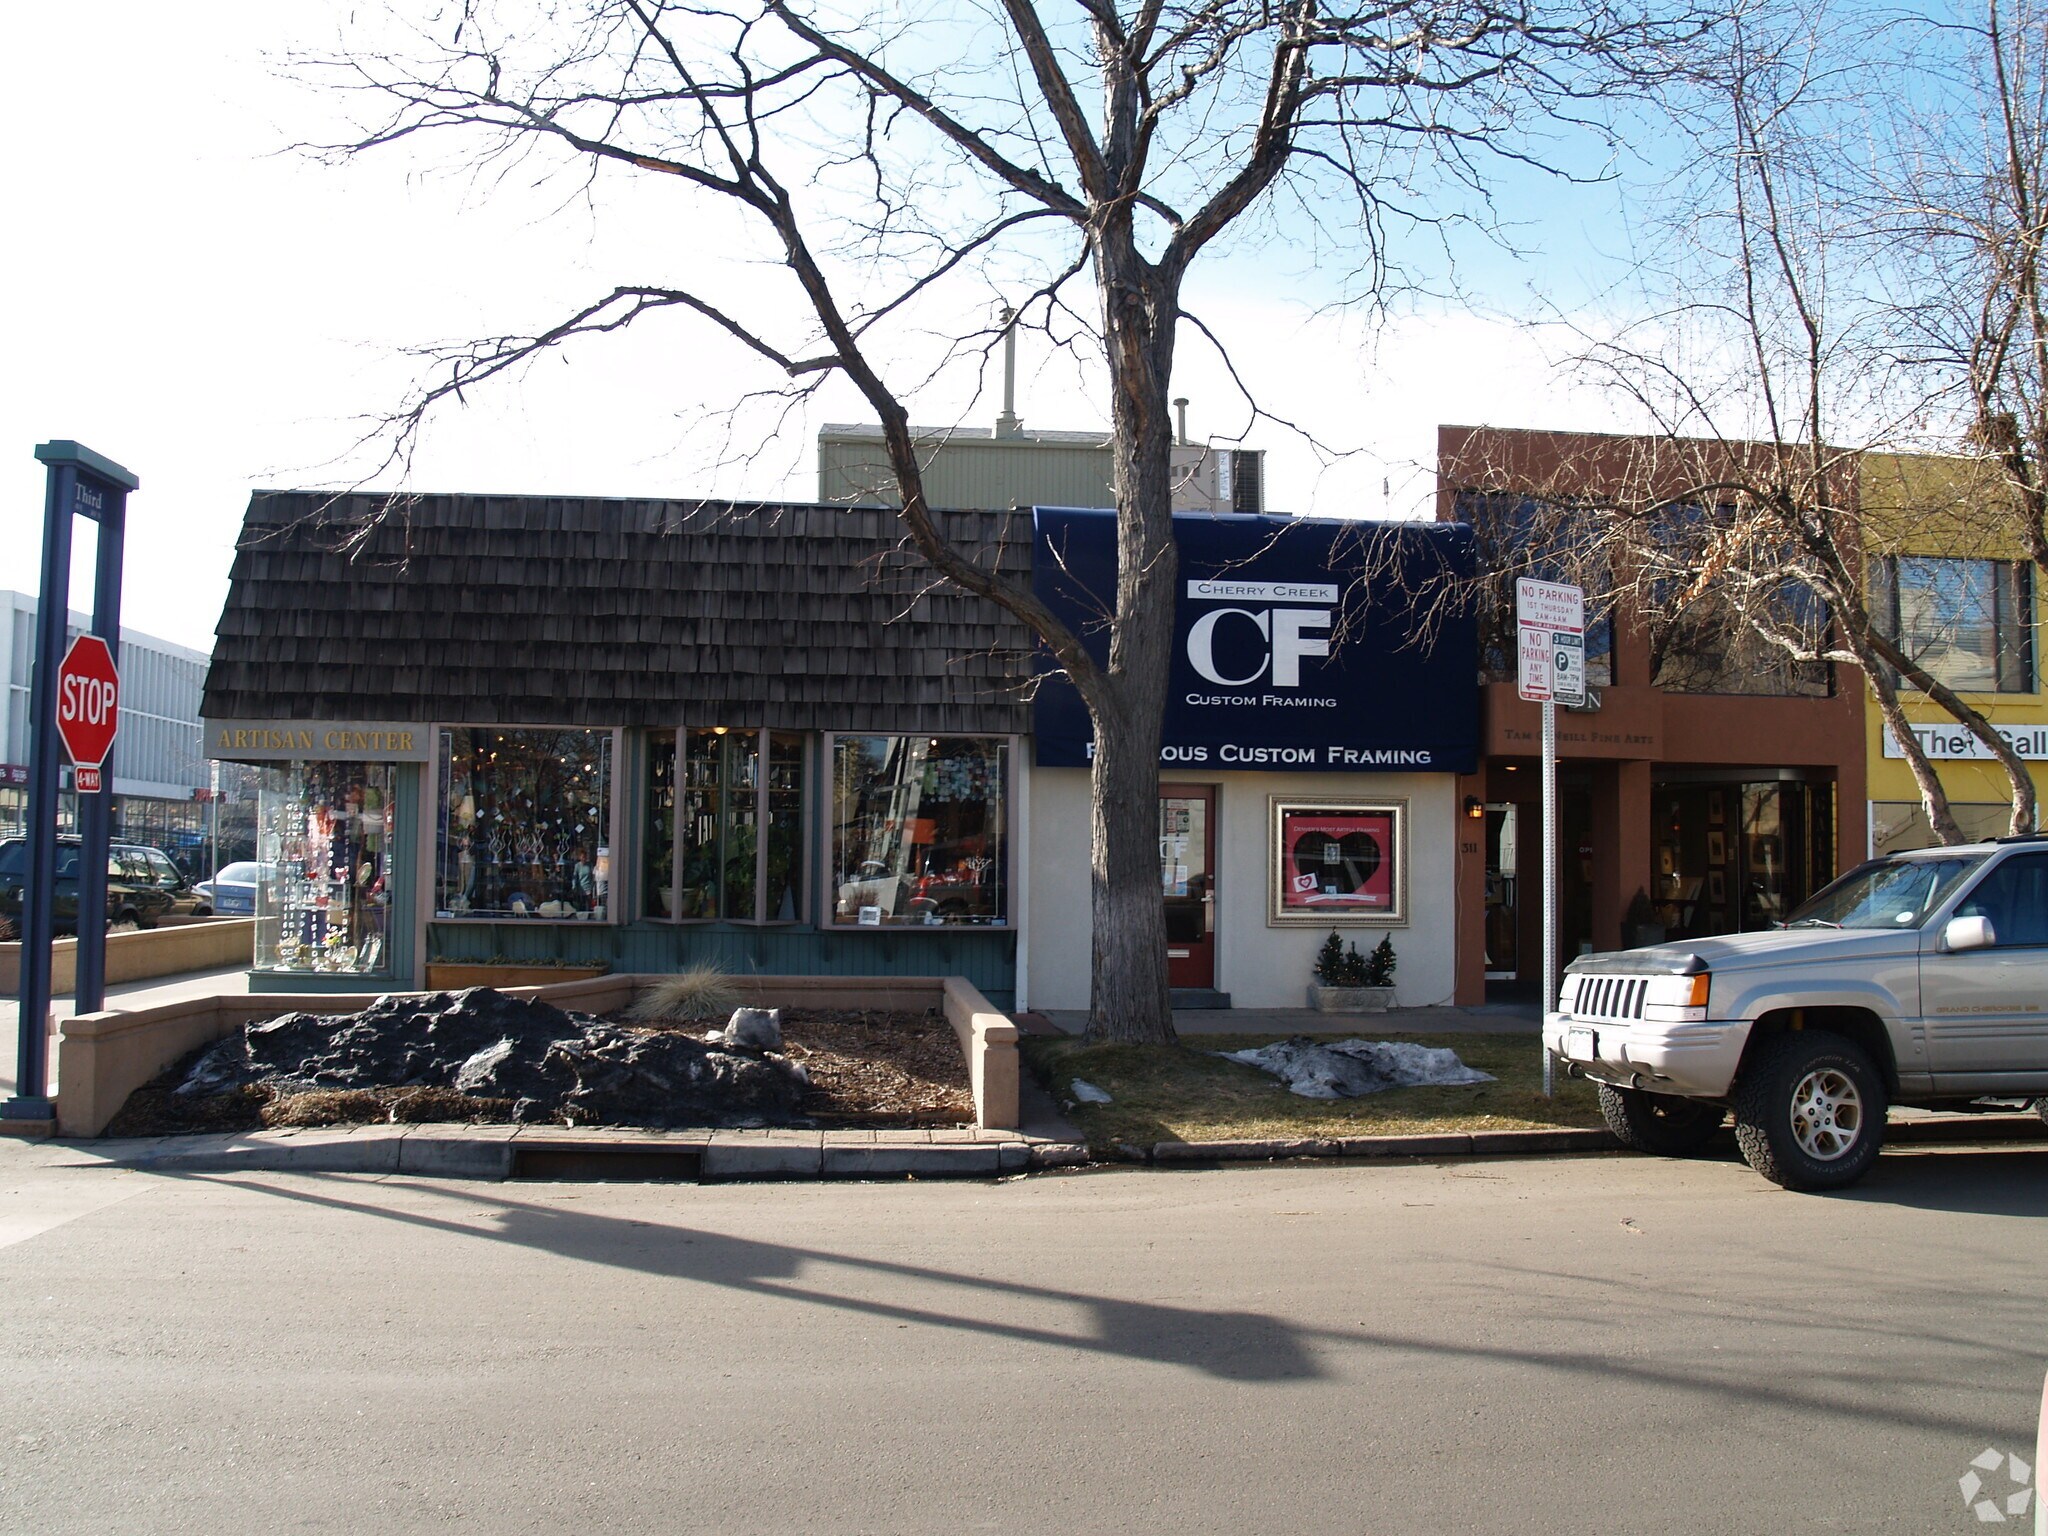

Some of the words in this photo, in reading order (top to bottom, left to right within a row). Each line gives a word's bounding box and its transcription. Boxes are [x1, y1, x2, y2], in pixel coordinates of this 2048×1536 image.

[75, 482, 102, 509] Third
[1198, 583, 1266, 596] CHERRY
[1273, 585, 1329, 598] CREEK
[1521, 585, 1534, 598] NO
[1538, 588, 1579, 605] PARKING
[1527, 601, 1537, 609] 1ST
[1540, 603, 1574, 615] THURSDAY
[1535, 611, 1567, 623] 2AM-6AM
[1529, 632, 1541, 647] NO
[1553, 633, 1559, 644] 3
[1187, 608, 1331, 687] CF
[1521, 646, 1549, 663] PARKING
[1529, 663, 1542, 674] ANY
[1529, 672, 1544, 684] TIME
[62, 673, 116, 726] STOP
[1186, 693, 1257, 706] CUSTOM
[1262, 695, 1338, 708] FRAMING
[217, 729, 314, 749] ARTISAN
[324, 730, 414, 751] CENTER
[1504, 729, 1532, 740] TAM
[1590, 731, 1621, 744] FINE
[1624, 733, 1654, 745] ARTS
[1911, 729, 1964, 755] The
[1219, 744, 1316, 763] CUSTOM
[1327, 746, 1432, 765] FRAMING
[78, 771, 99, 787] 4-WAY
